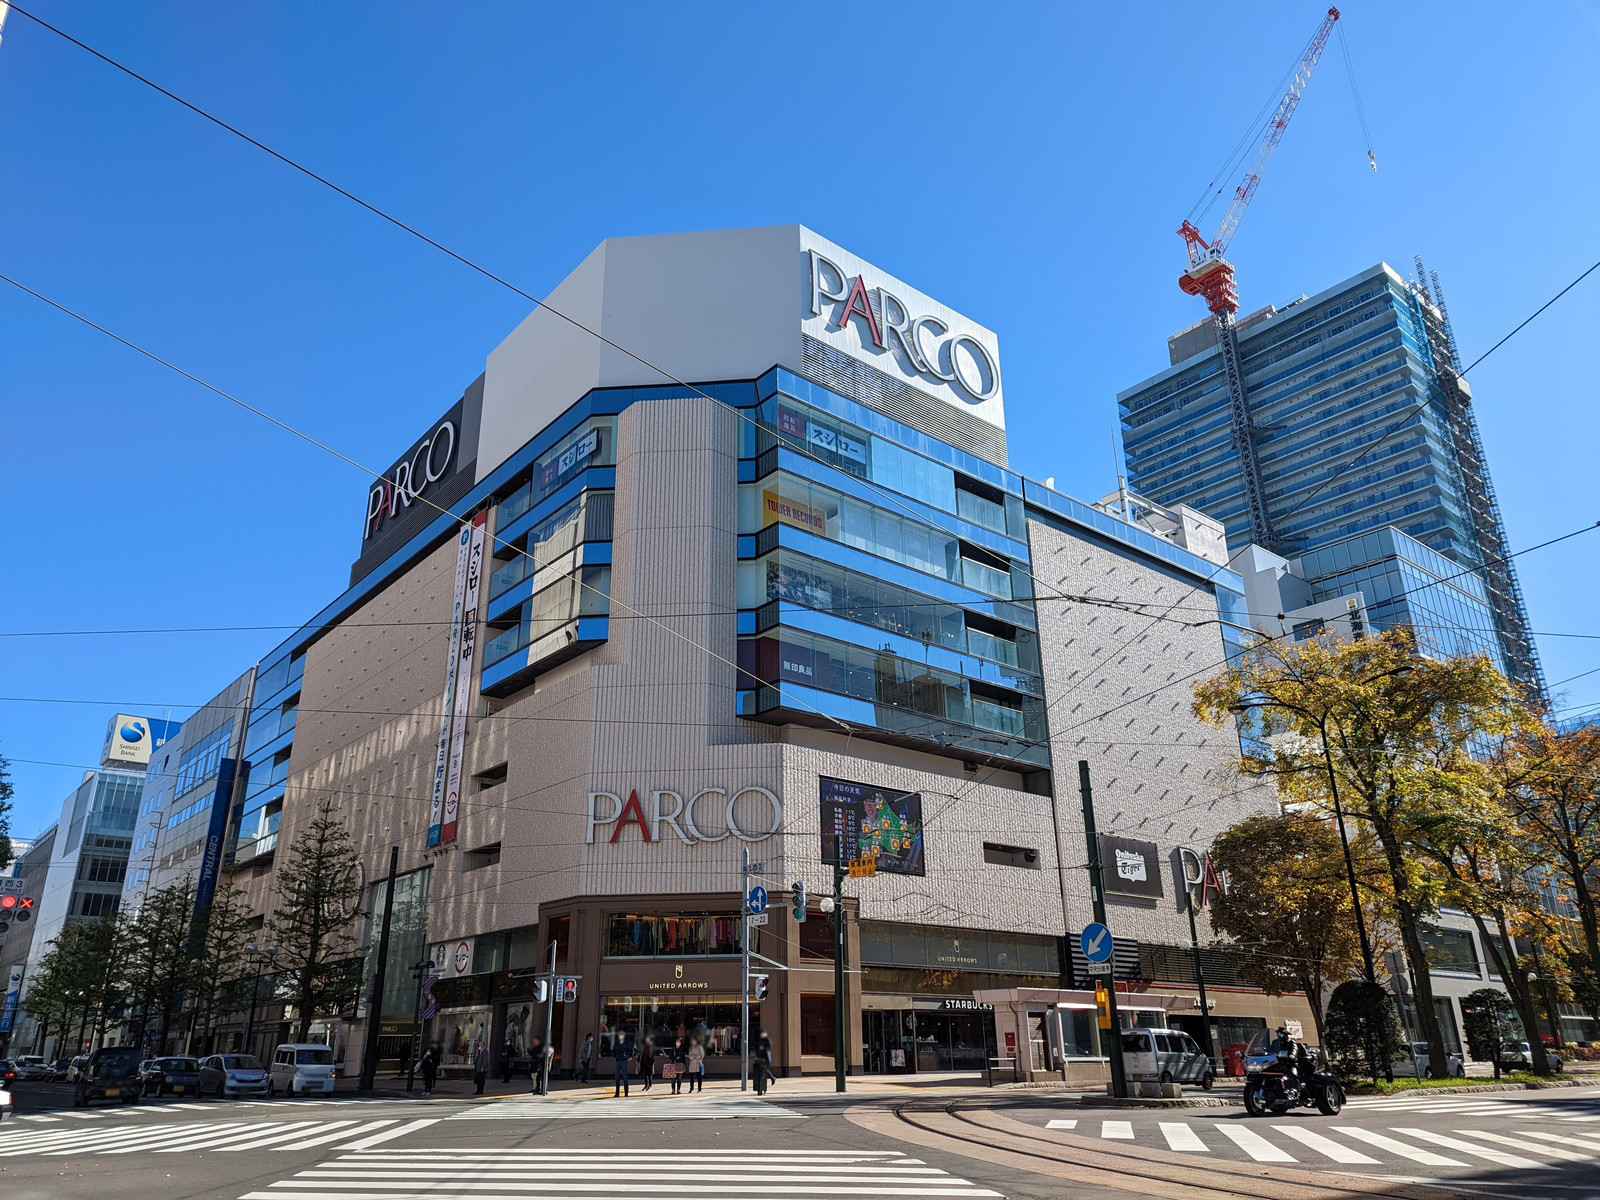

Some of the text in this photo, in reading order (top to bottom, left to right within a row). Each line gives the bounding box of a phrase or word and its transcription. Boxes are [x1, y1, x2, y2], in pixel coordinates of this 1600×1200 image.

[808, 248, 999, 400] PARCO
[560, 441, 593, 471] スシロー
[811, 428, 859, 454] スシロー
[364, 421, 454, 541] PARCO
[767, 498, 823, 529] TOWER RECORDS
[468, 542, 481, 604] スシロー
[783, 660, 812, 677] 無印良品
[119, 743, 141, 752] SHINSEI
[833, 783, 861, 795] 今日の天気
[585, 786, 782, 846] PARCO
[203, 835, 219, 881] CENTRAL
[1121, 861, 1141, 875] Tiger
